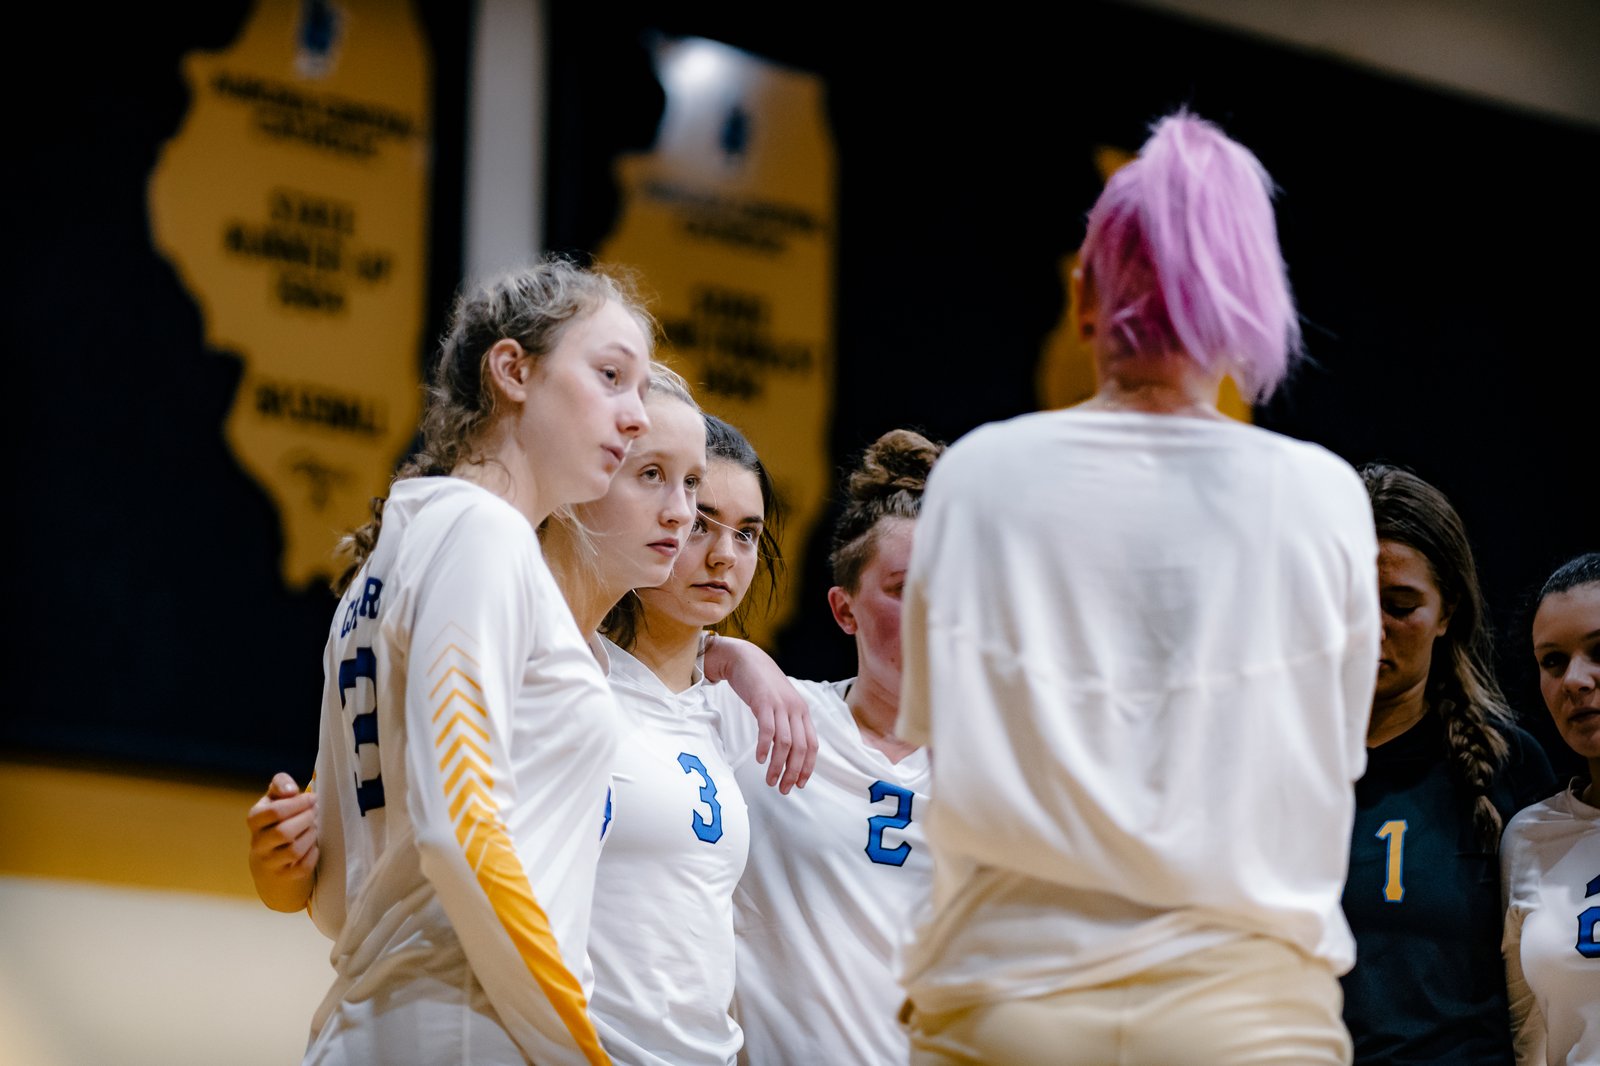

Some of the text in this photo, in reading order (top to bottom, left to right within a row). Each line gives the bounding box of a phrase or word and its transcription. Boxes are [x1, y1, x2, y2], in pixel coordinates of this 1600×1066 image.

[677, 752, 723, 844] 3
[864, 780, 915, 867] 2
[1375, 819, 1408, 902] 1
